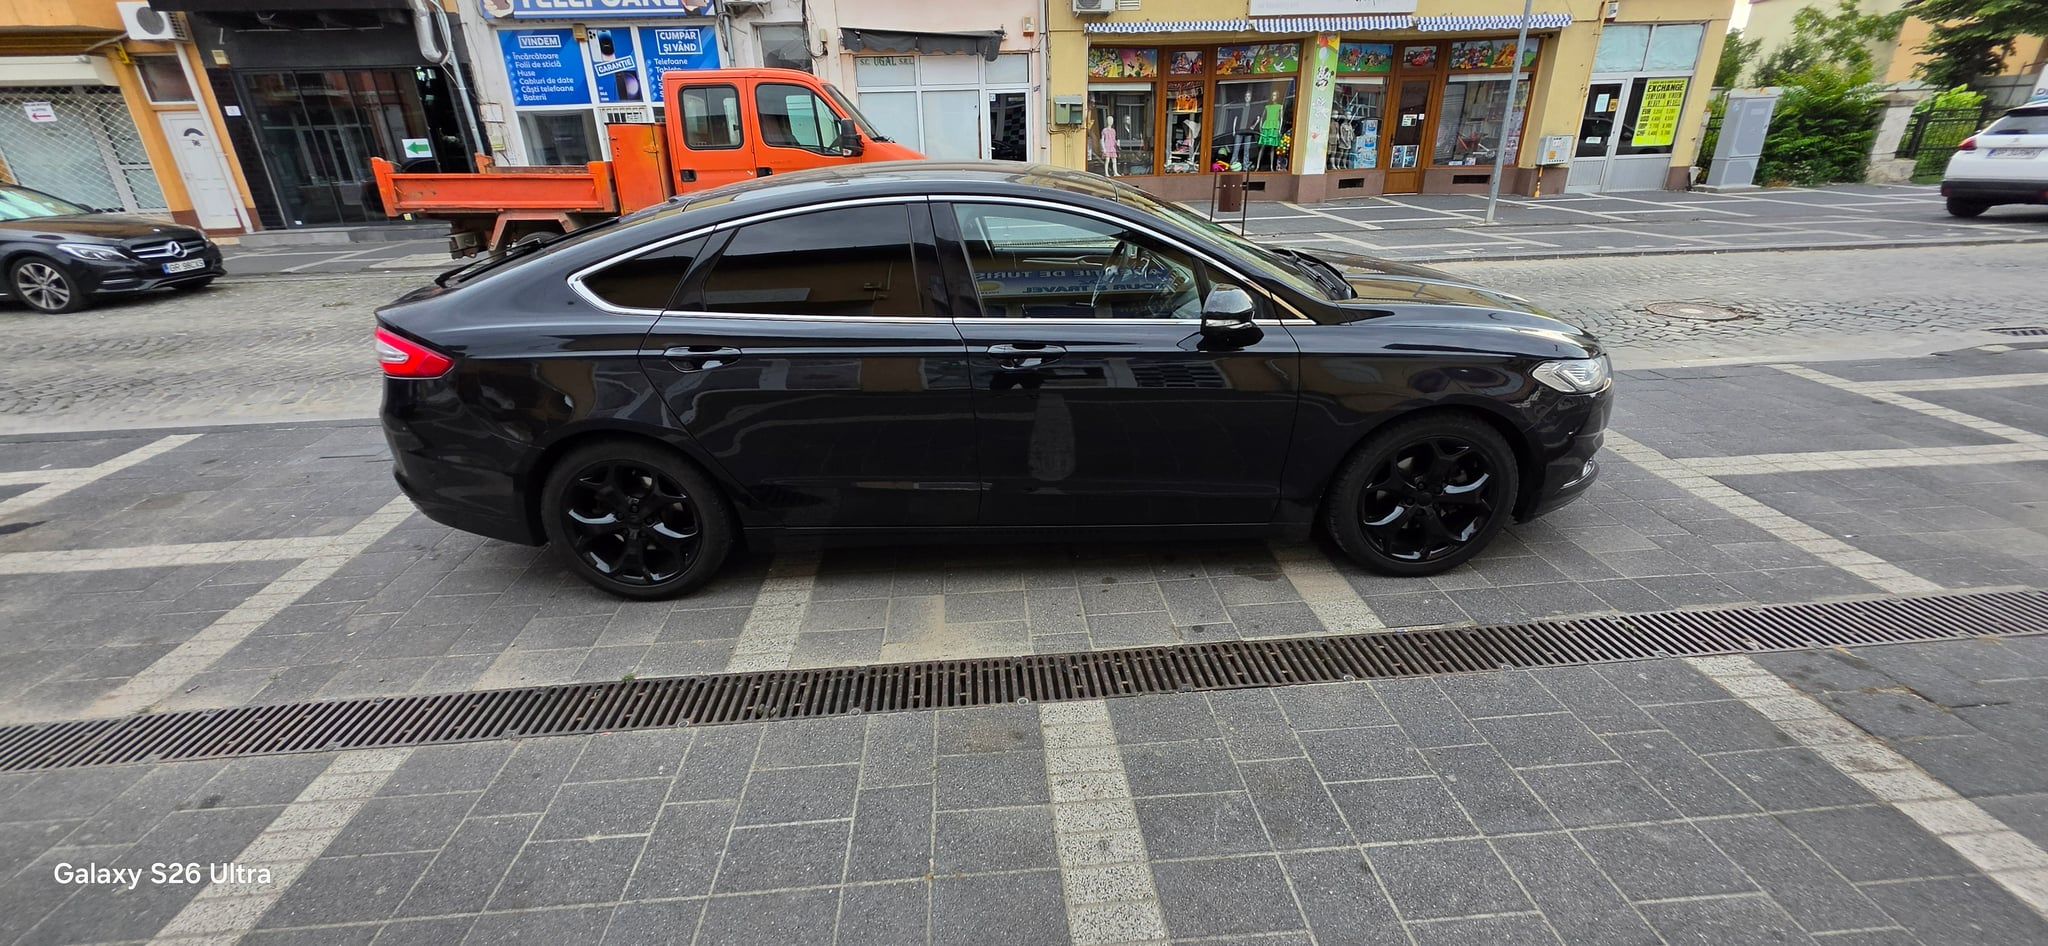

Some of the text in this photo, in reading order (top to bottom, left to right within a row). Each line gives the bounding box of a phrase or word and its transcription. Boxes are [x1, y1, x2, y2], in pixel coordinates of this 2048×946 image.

[521, 37, 558, 46] VINDEM
[672, 41, 697, 51] VÂND
[873, 56, 897, 66] UGAL
[519, 77, 545, 85] Cabluri
[1647, 83, 1684, 92] EXCHANGE
